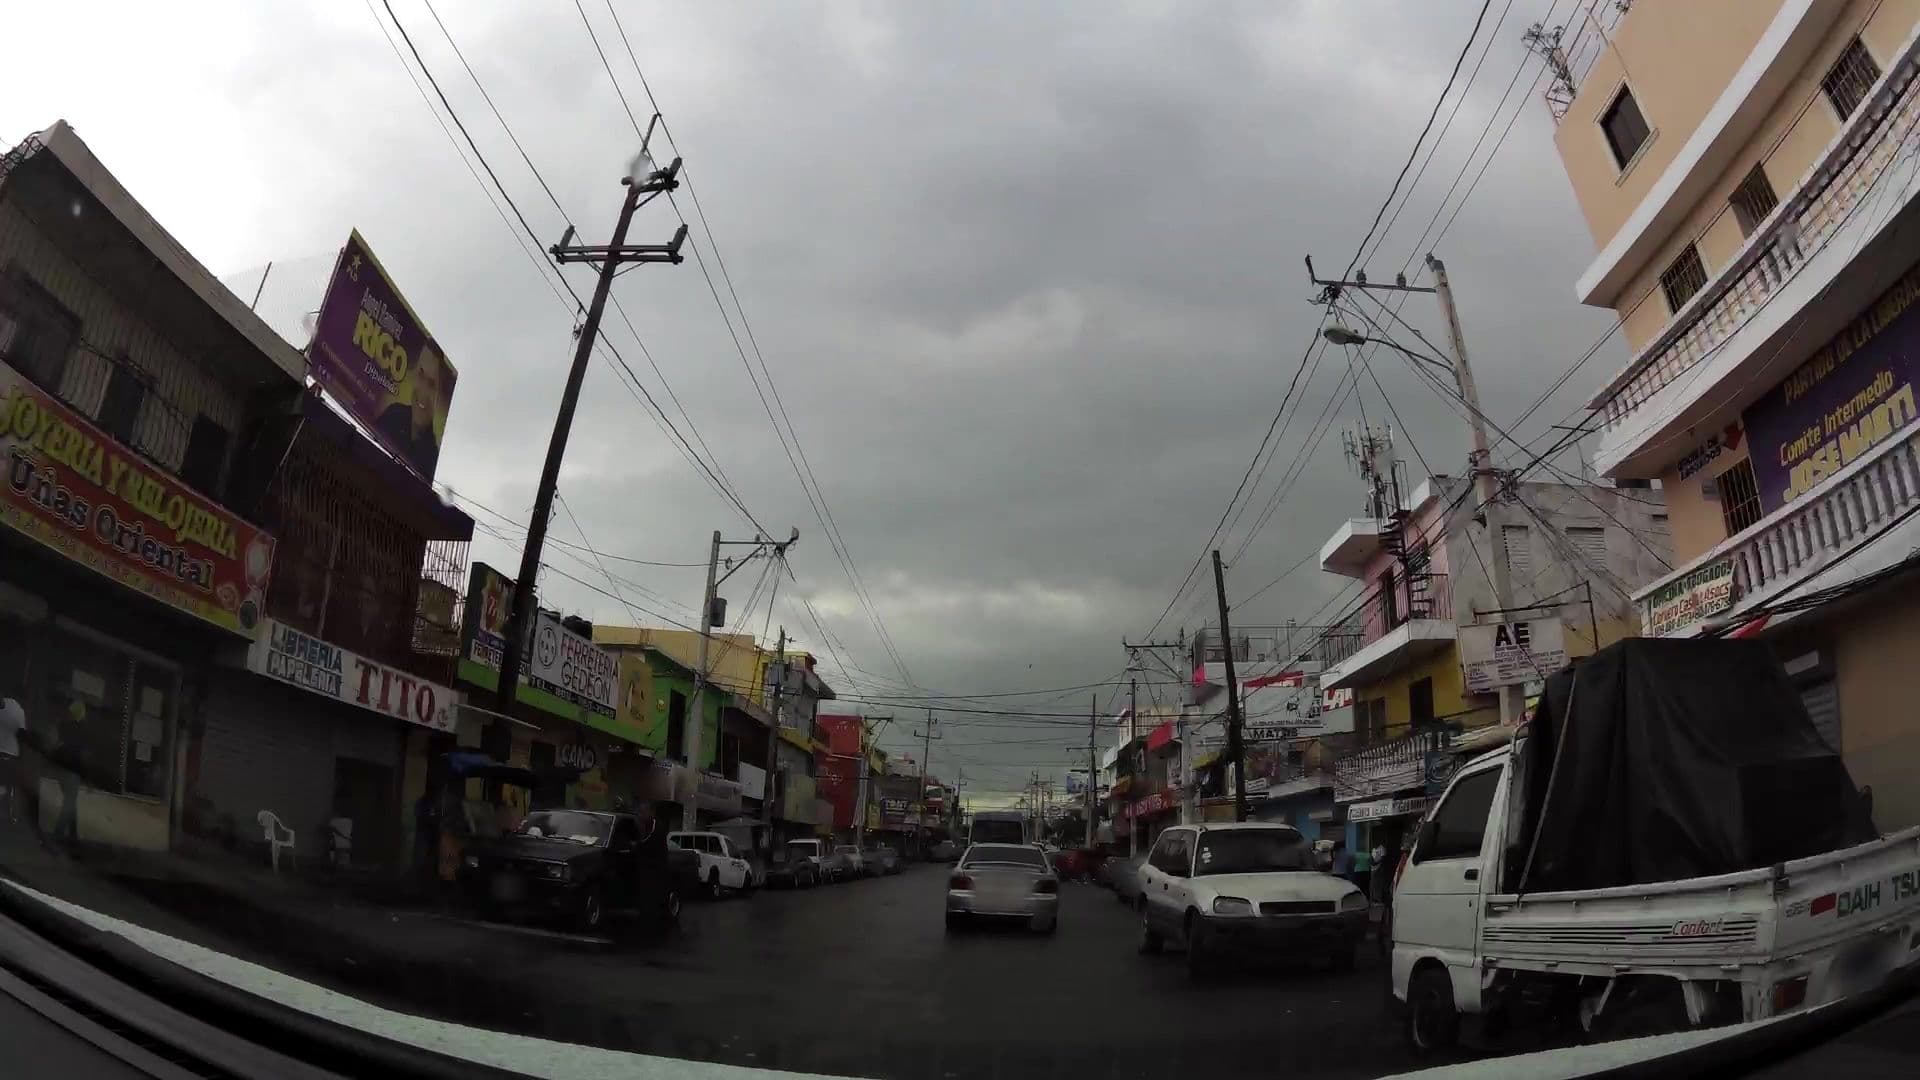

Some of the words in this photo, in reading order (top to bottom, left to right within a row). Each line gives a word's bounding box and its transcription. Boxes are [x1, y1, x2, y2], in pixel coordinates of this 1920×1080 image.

[353, 311, 408, 383] RICO
[1824, 368, 1894, 434] Intermedio
[105, 453, 129, 495] Y
[1783, 438, 1841, 503] JOSE
[1840, 382, 1917, 467] MARTI
[9, 446, 89, 531] Uñas
[95, 503, 215, 593] Oriental
[271, 620, 343, 674] LIBRERIA
[353, 660, 436, 723] TITO
[560, 633, 619, 680] FERRETERIA
[560, 660, 612, 705] GEDEON
